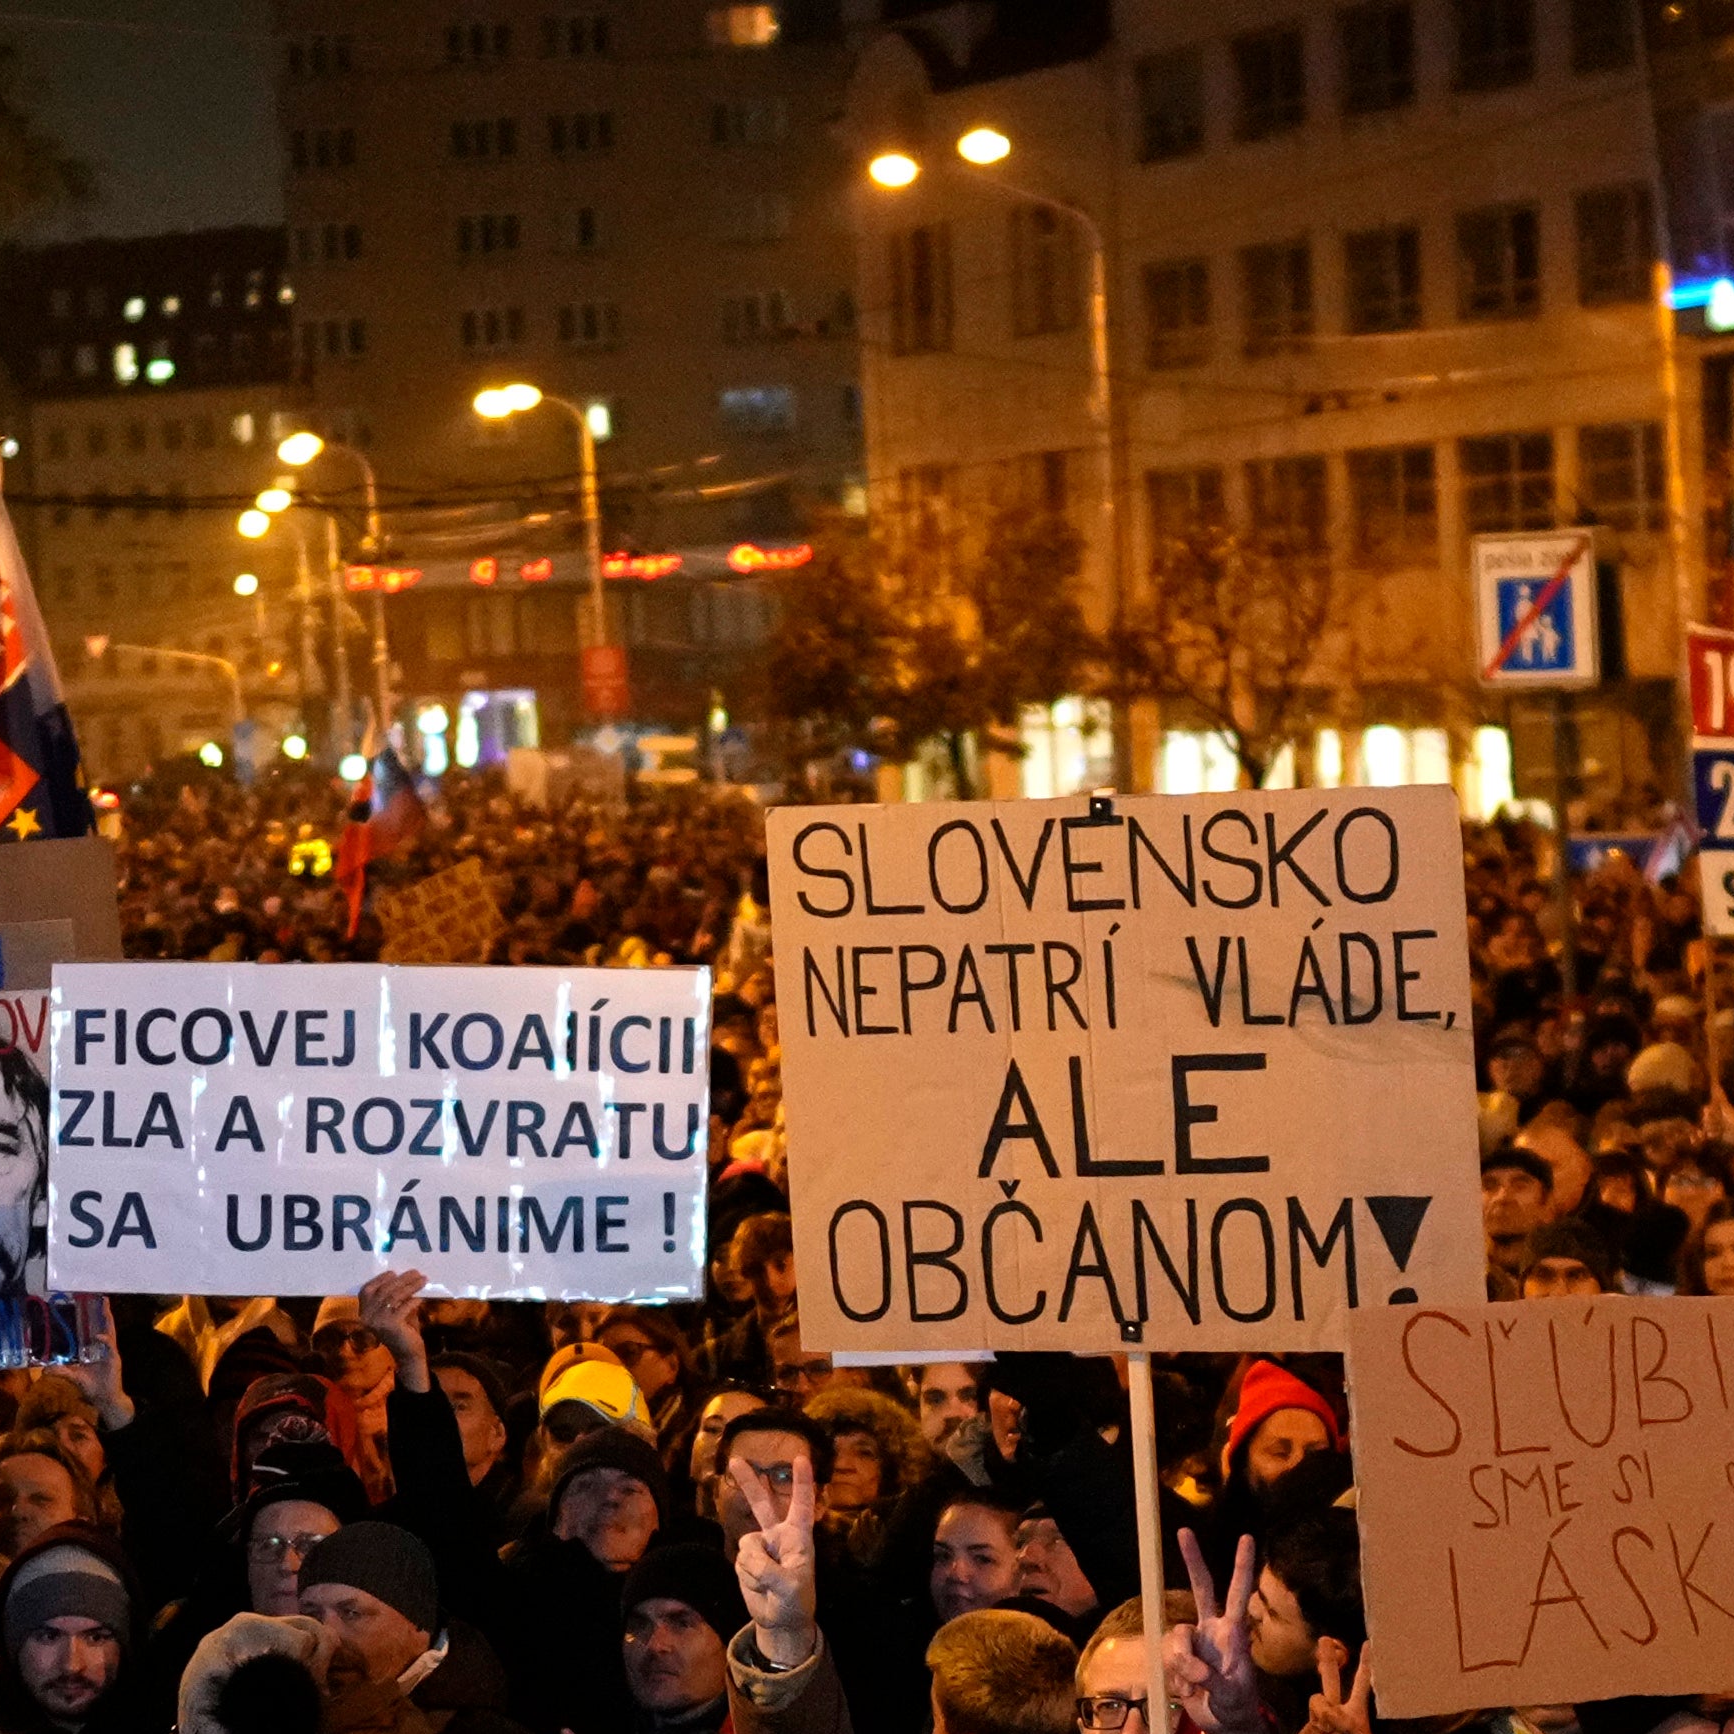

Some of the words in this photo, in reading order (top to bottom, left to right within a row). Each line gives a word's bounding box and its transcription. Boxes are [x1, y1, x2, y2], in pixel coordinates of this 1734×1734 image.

[791, 805, 1401, 919] SLOVENSKO
[801, 921, 1120, 1037] NEPATRÍ
[1184, 916, 1459, 1031] VLÁDE,
[73, 1007, 357, 1068] FICOVEJ
[58, 1089, 185, 1150] ZLA
[214, 1095, 266, 1153] A
[305, 1096, 701, 1161] ROZVRATU
[976, 1051, 1272, 1179] ALE
[66, 1190, 158, 1250] SA
[225, 1177, 631, 1255] UBRÁNIME
[662, 1191, 678, 1254] !
[826, 1178, 1434, 1325] OBČANOM!
[1468, 1459, 1584, 1529] SME
[1610, 1450, 1656, 1505] SI
